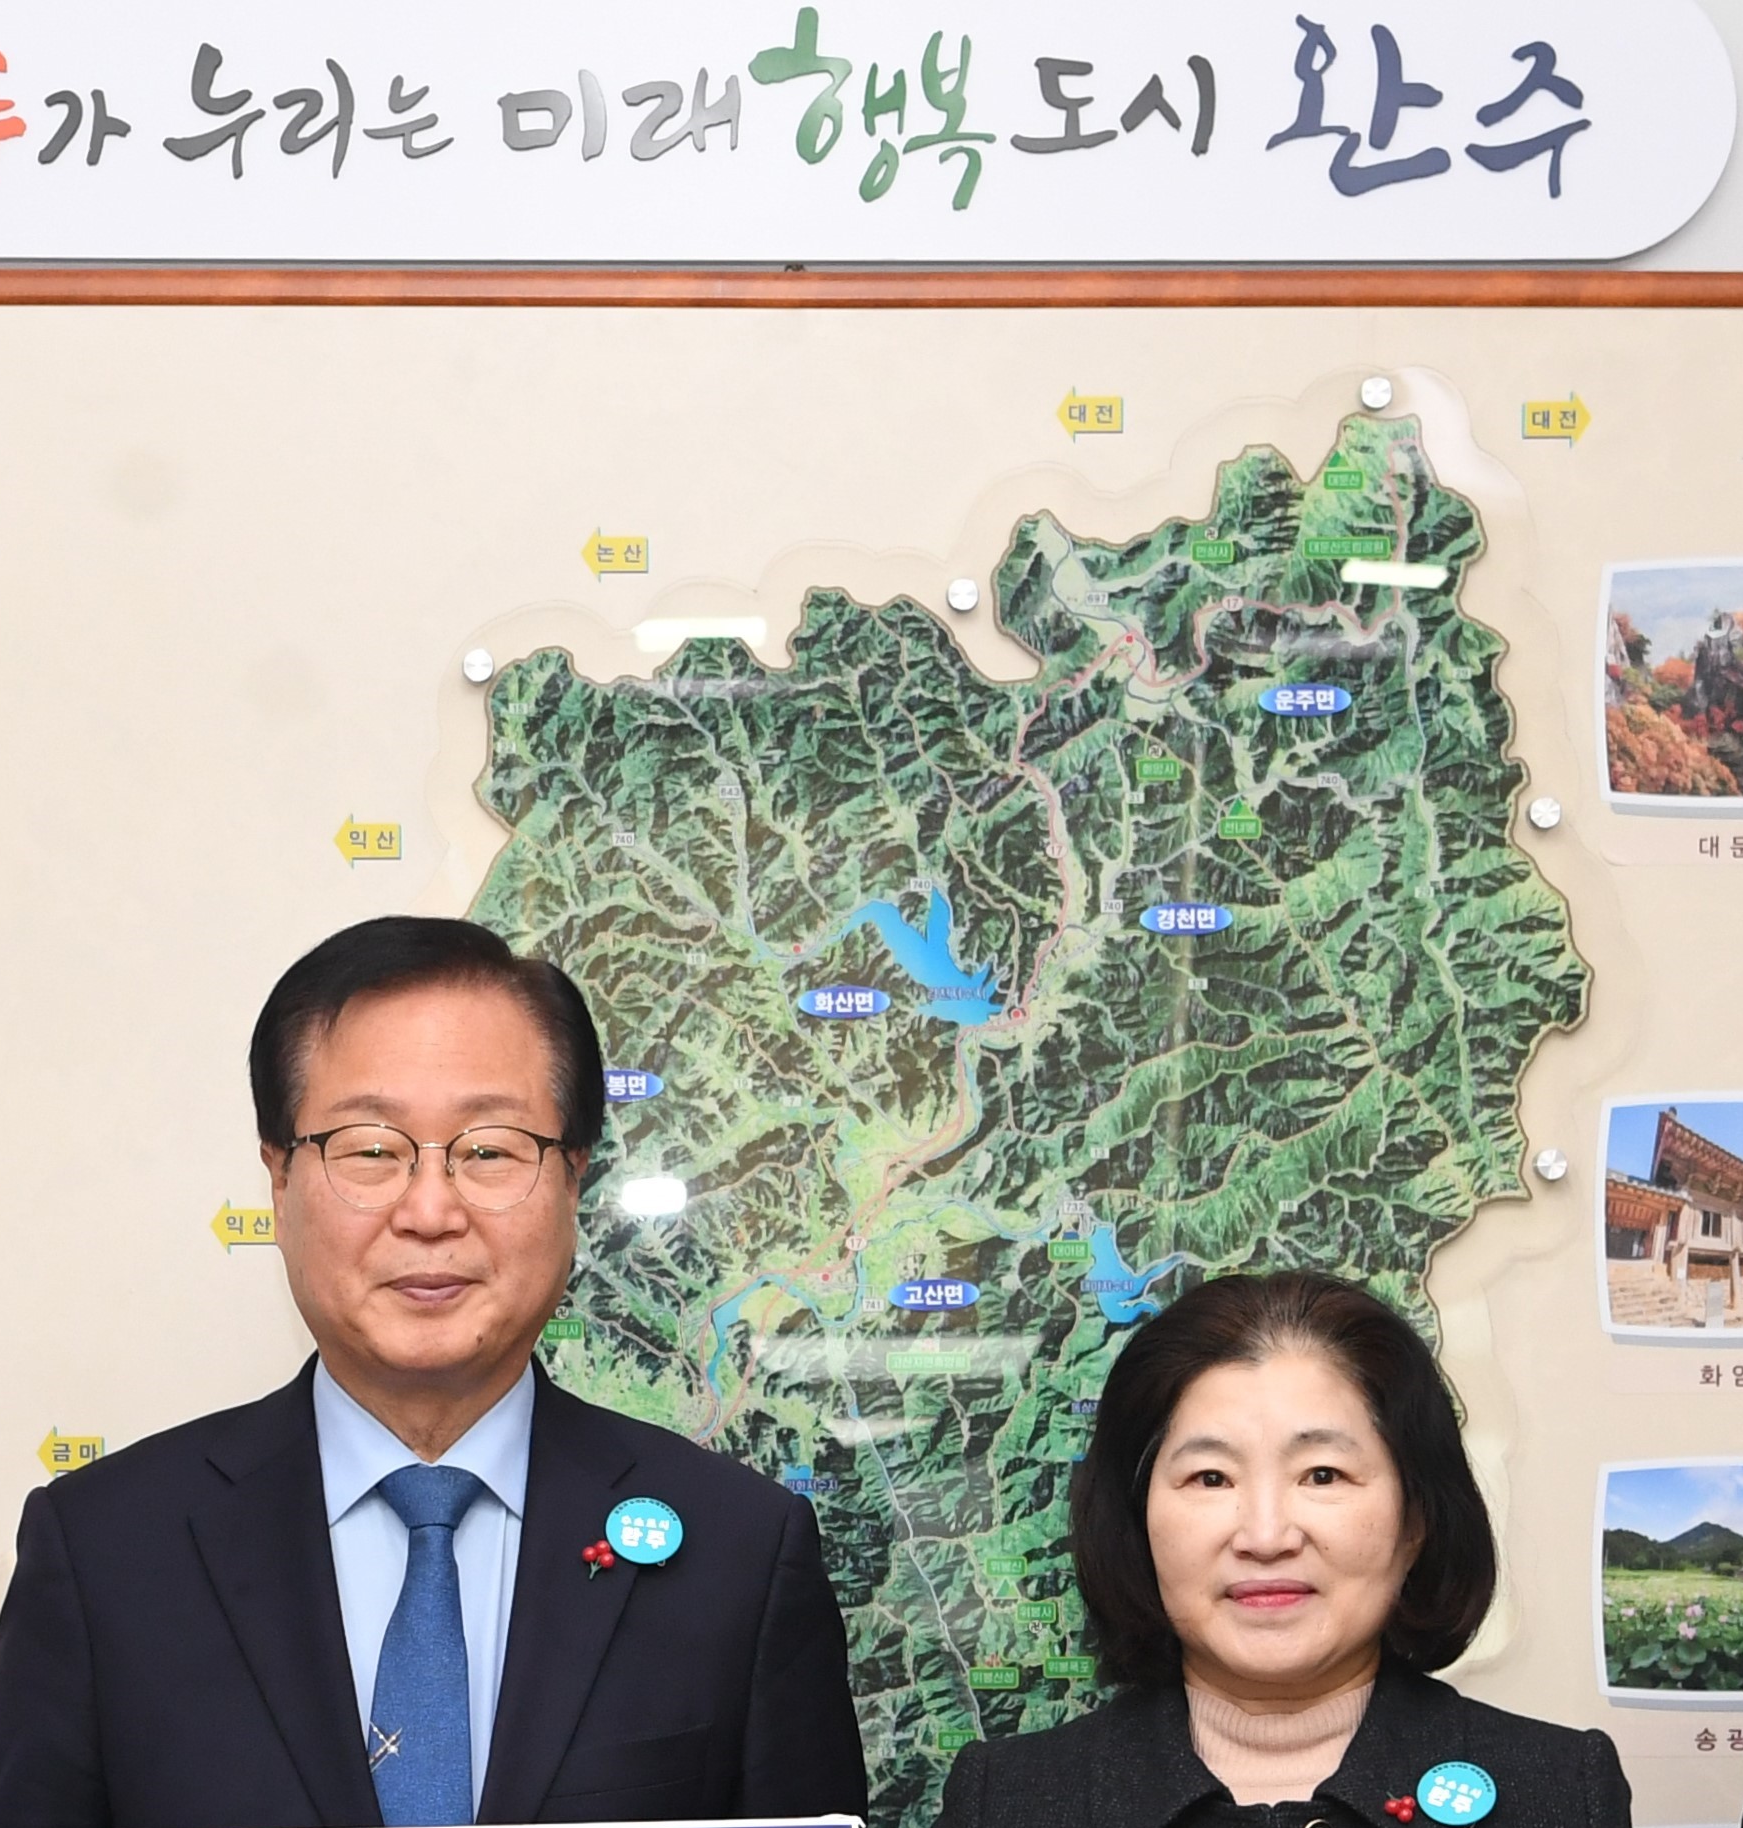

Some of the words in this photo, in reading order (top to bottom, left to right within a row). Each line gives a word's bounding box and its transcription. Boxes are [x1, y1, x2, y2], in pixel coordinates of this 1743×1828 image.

[163, 43, 454, 180] 누리는
[497, 67, 741, 162] 미래
[748, 7, 997, 211] 행복
[1010, 55, 1216, 157] 도시
[1266, 14, 1592, 199] 완주
[1273, 688, 1336, 713] 운주면
[1156, 906, 1218, 932] 경천면
[813, 989, 875, 1015] 화산면
[903, 1281, 964, 1308] 고산면
